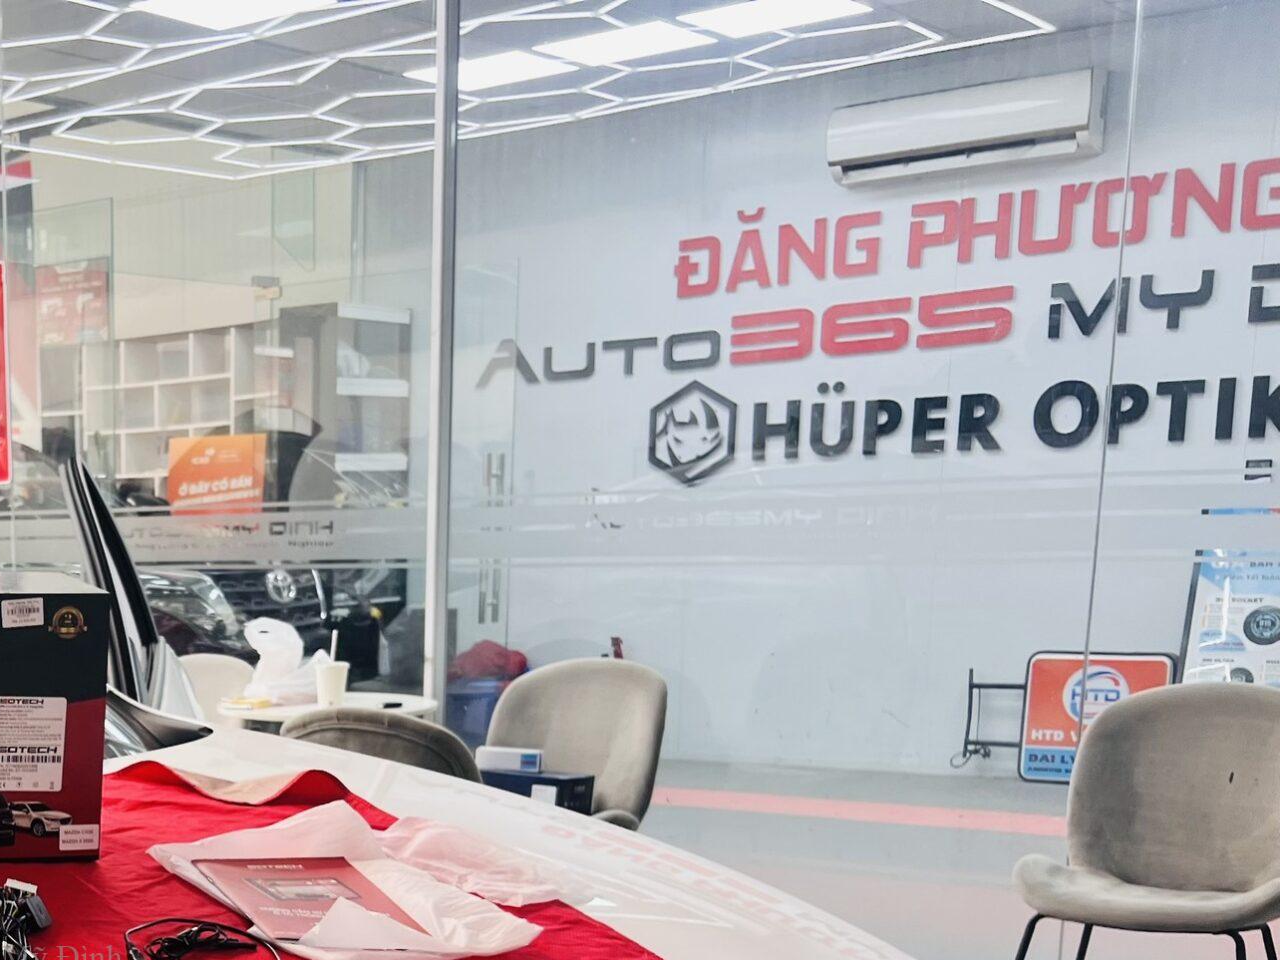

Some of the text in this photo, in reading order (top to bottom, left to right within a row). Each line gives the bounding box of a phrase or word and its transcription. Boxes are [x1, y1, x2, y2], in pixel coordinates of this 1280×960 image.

[675, 158, 1280, 299] ĐĂNG PHƯƠNG
[475, 284, 1014, 389] AUTO365
[1048, 269, 1216, 339] MY
[751, 375, 1280, 461] HÜPER OPTIK
[1031, 729, 1064, 742] HTD
